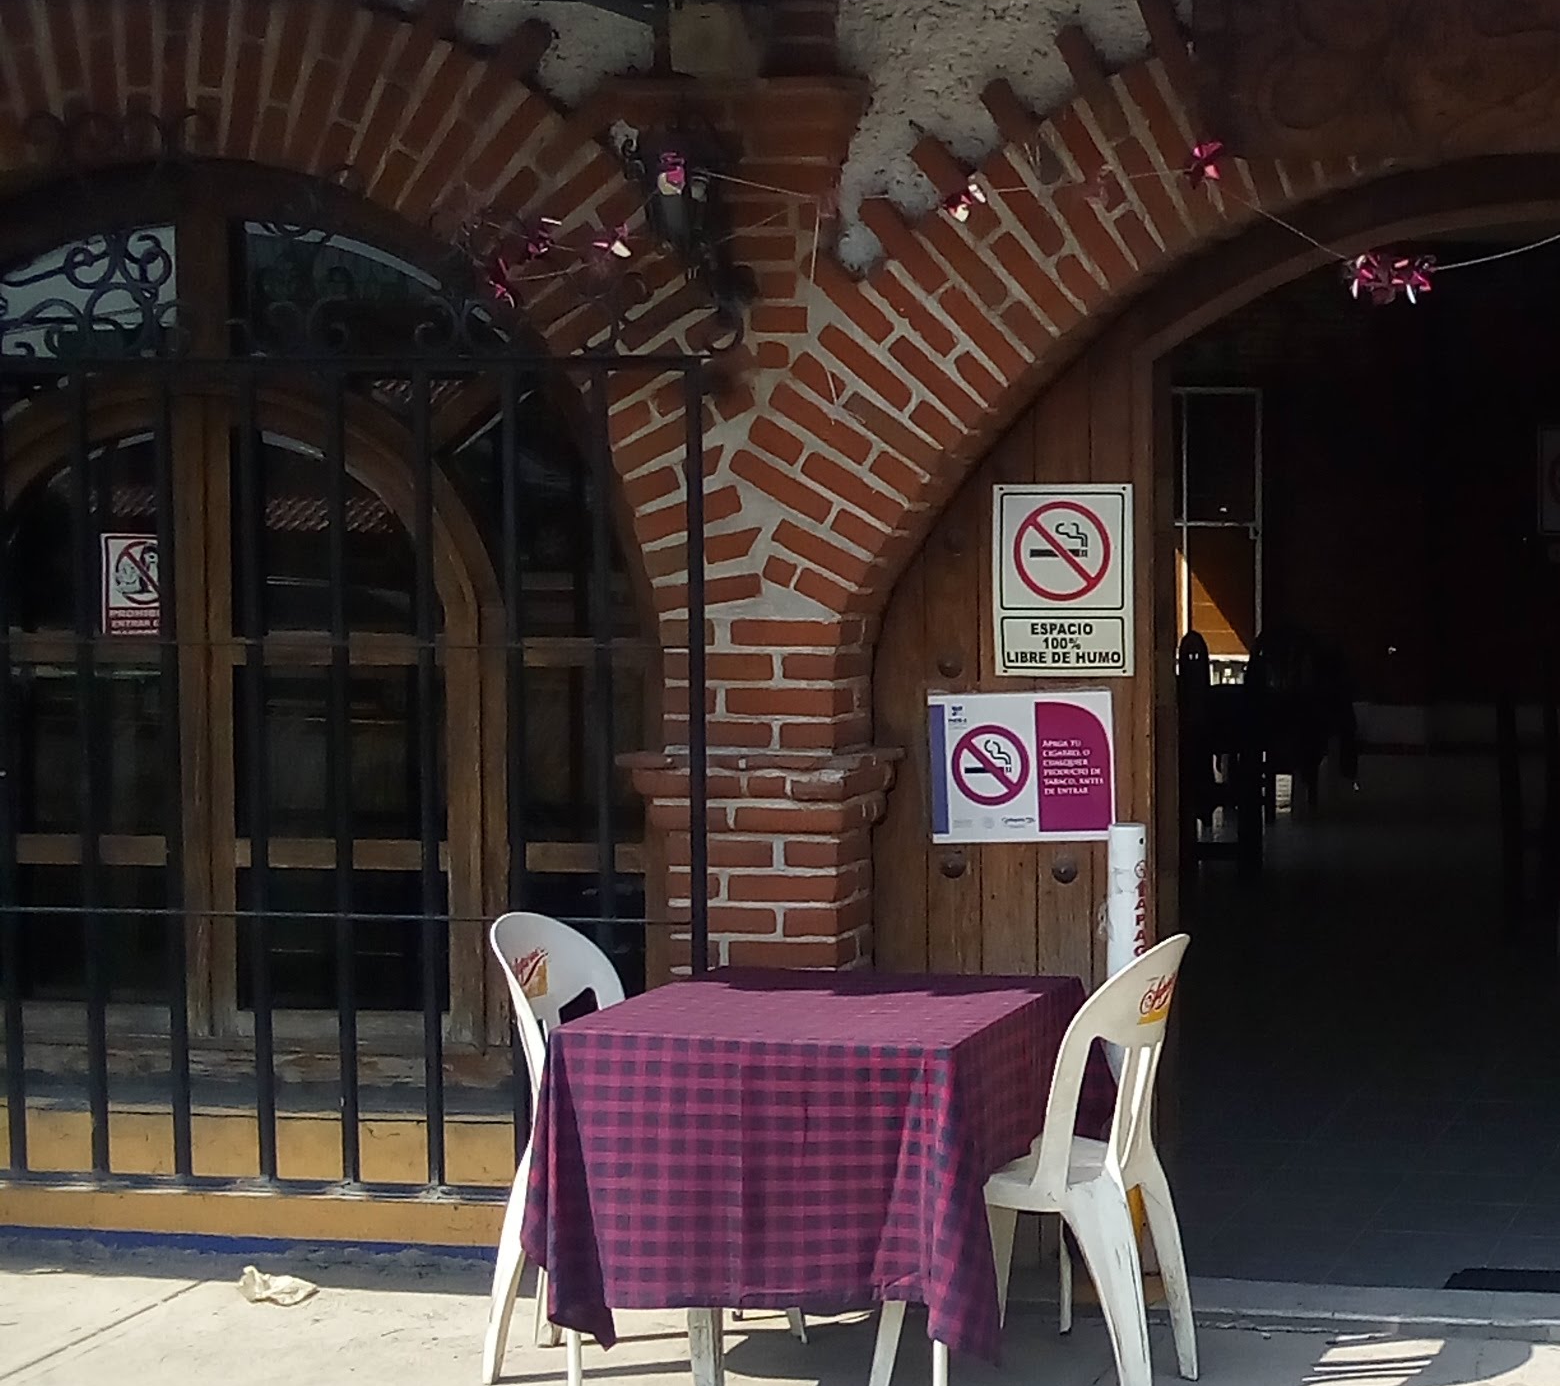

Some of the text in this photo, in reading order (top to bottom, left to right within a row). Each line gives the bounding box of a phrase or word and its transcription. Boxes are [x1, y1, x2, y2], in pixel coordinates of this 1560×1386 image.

[109, 609, 159, 618] PROHIBI
[1030, 623, 1093, 635] ESPACIO
[1042, 637, 1081, 649] 100%
[1006, 651, 1121, 663] LIBRE DE HUMO
